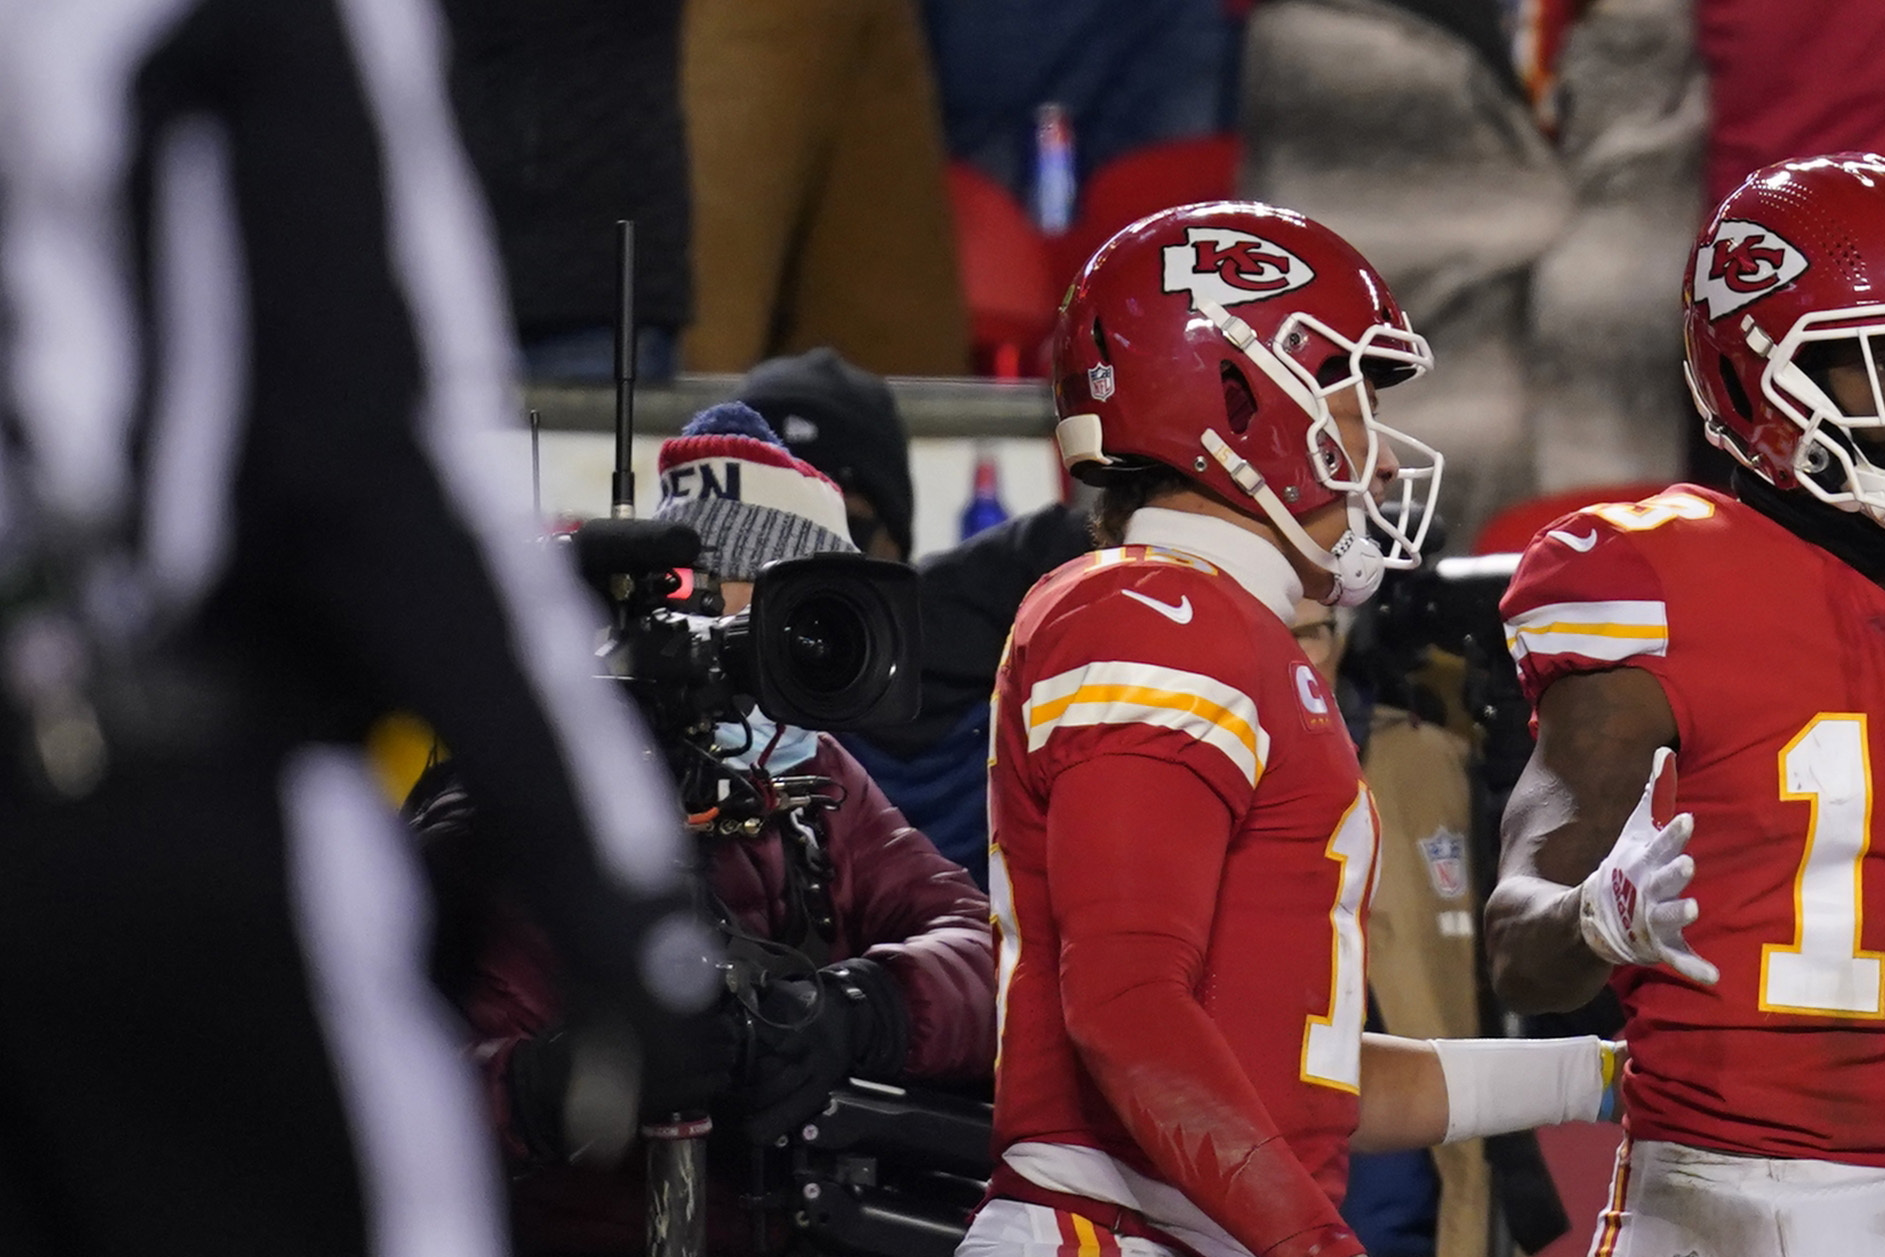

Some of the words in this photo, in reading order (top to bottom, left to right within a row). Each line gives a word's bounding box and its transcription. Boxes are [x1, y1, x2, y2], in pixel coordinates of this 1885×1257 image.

[1191, 240, 1290, 292] KC
[1708, 234, 1786, 293] KC
[1296, 665, 1328, 714] C
